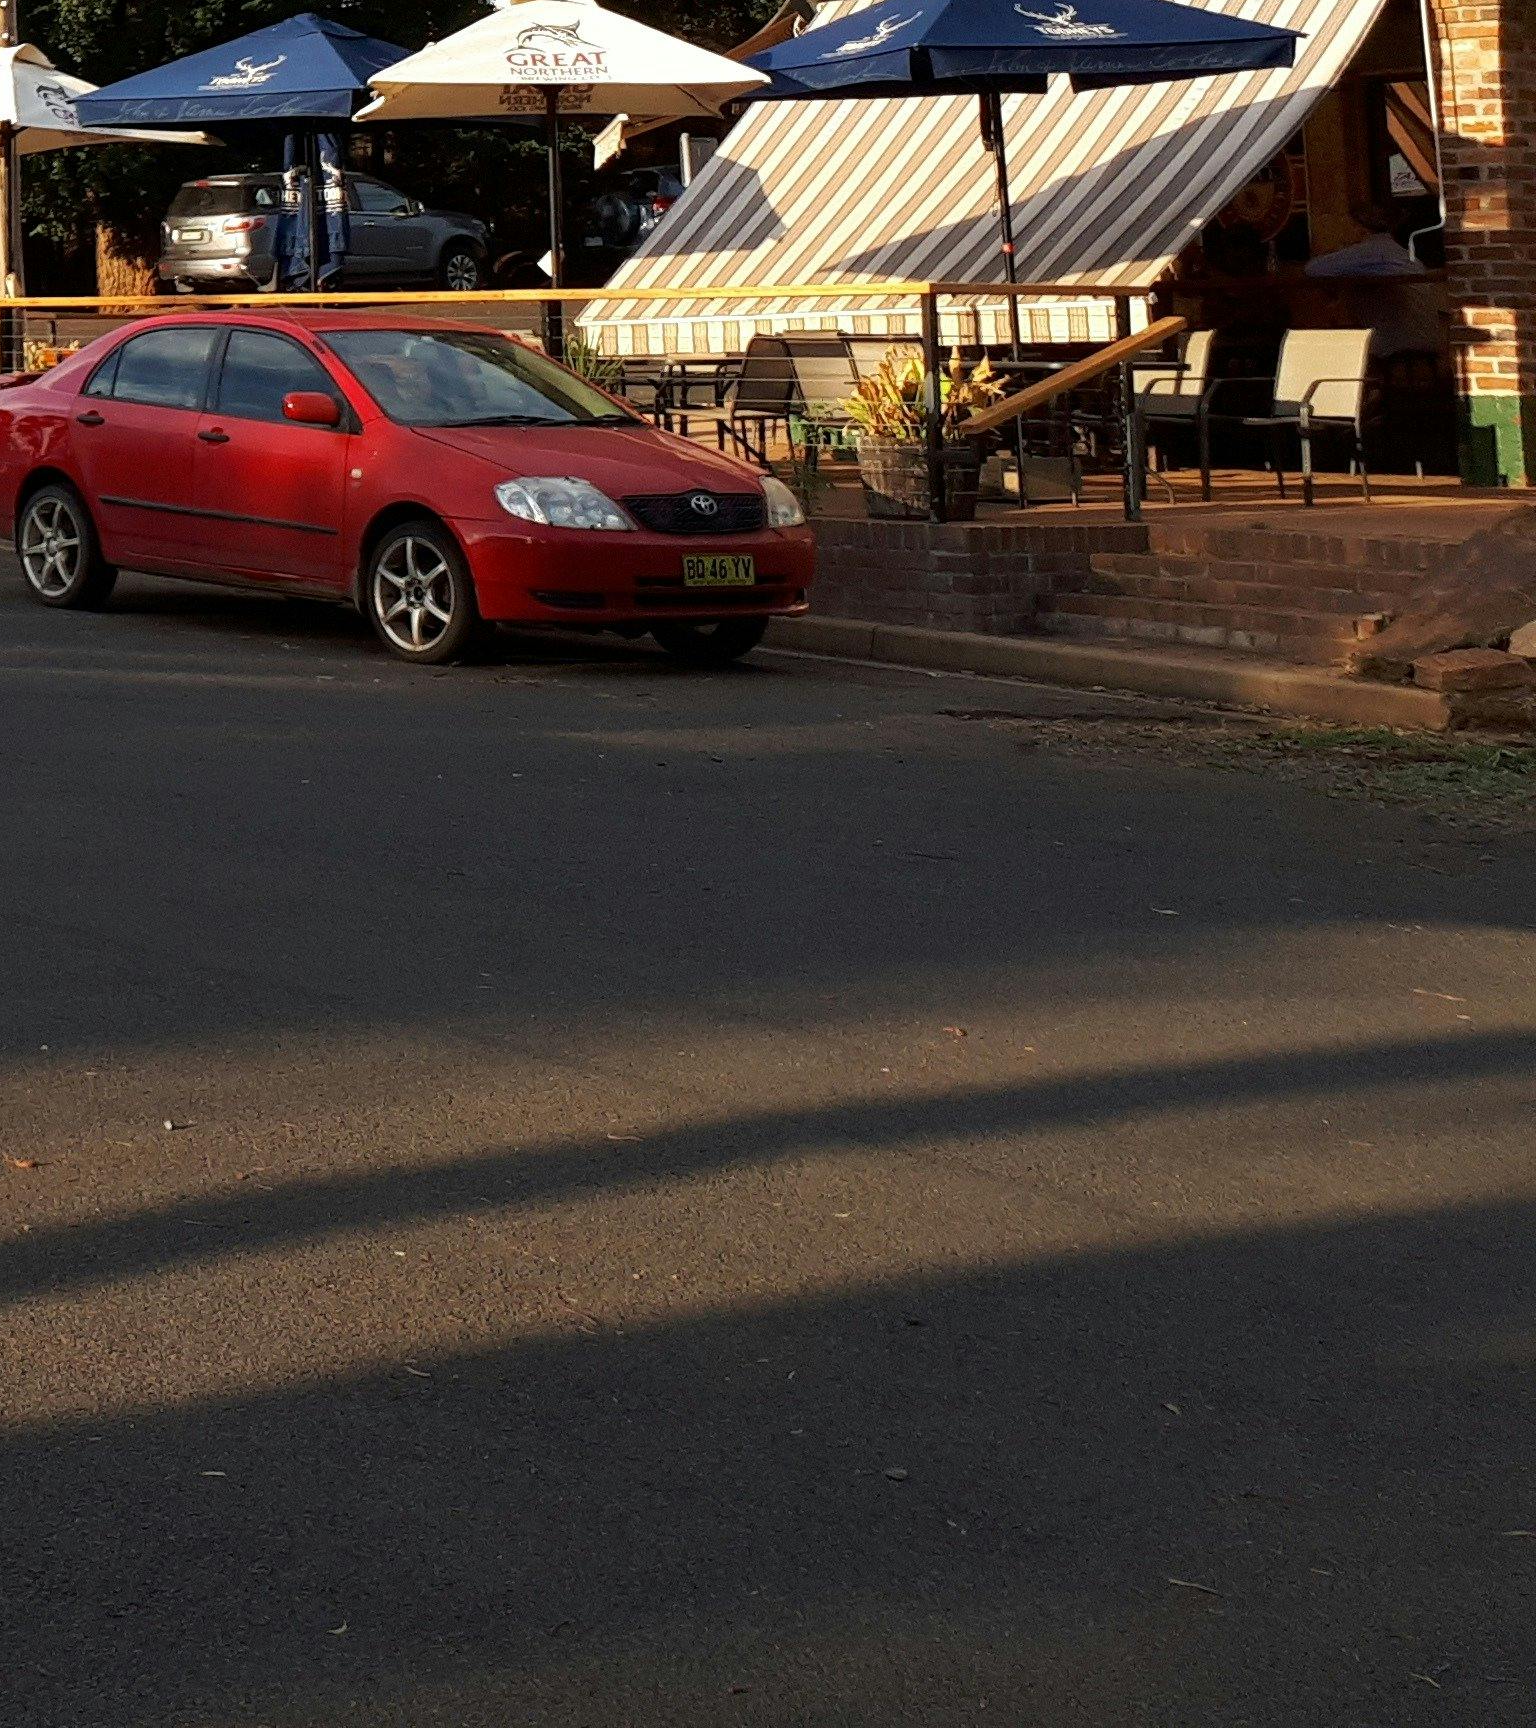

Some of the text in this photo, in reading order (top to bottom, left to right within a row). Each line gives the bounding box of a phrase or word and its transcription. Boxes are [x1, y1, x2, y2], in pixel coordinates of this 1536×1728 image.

[506, 51, 607, 67] GREAT
[510, 66, 609, 76] NORTHERN
[709, 558, 728, 579] 46
